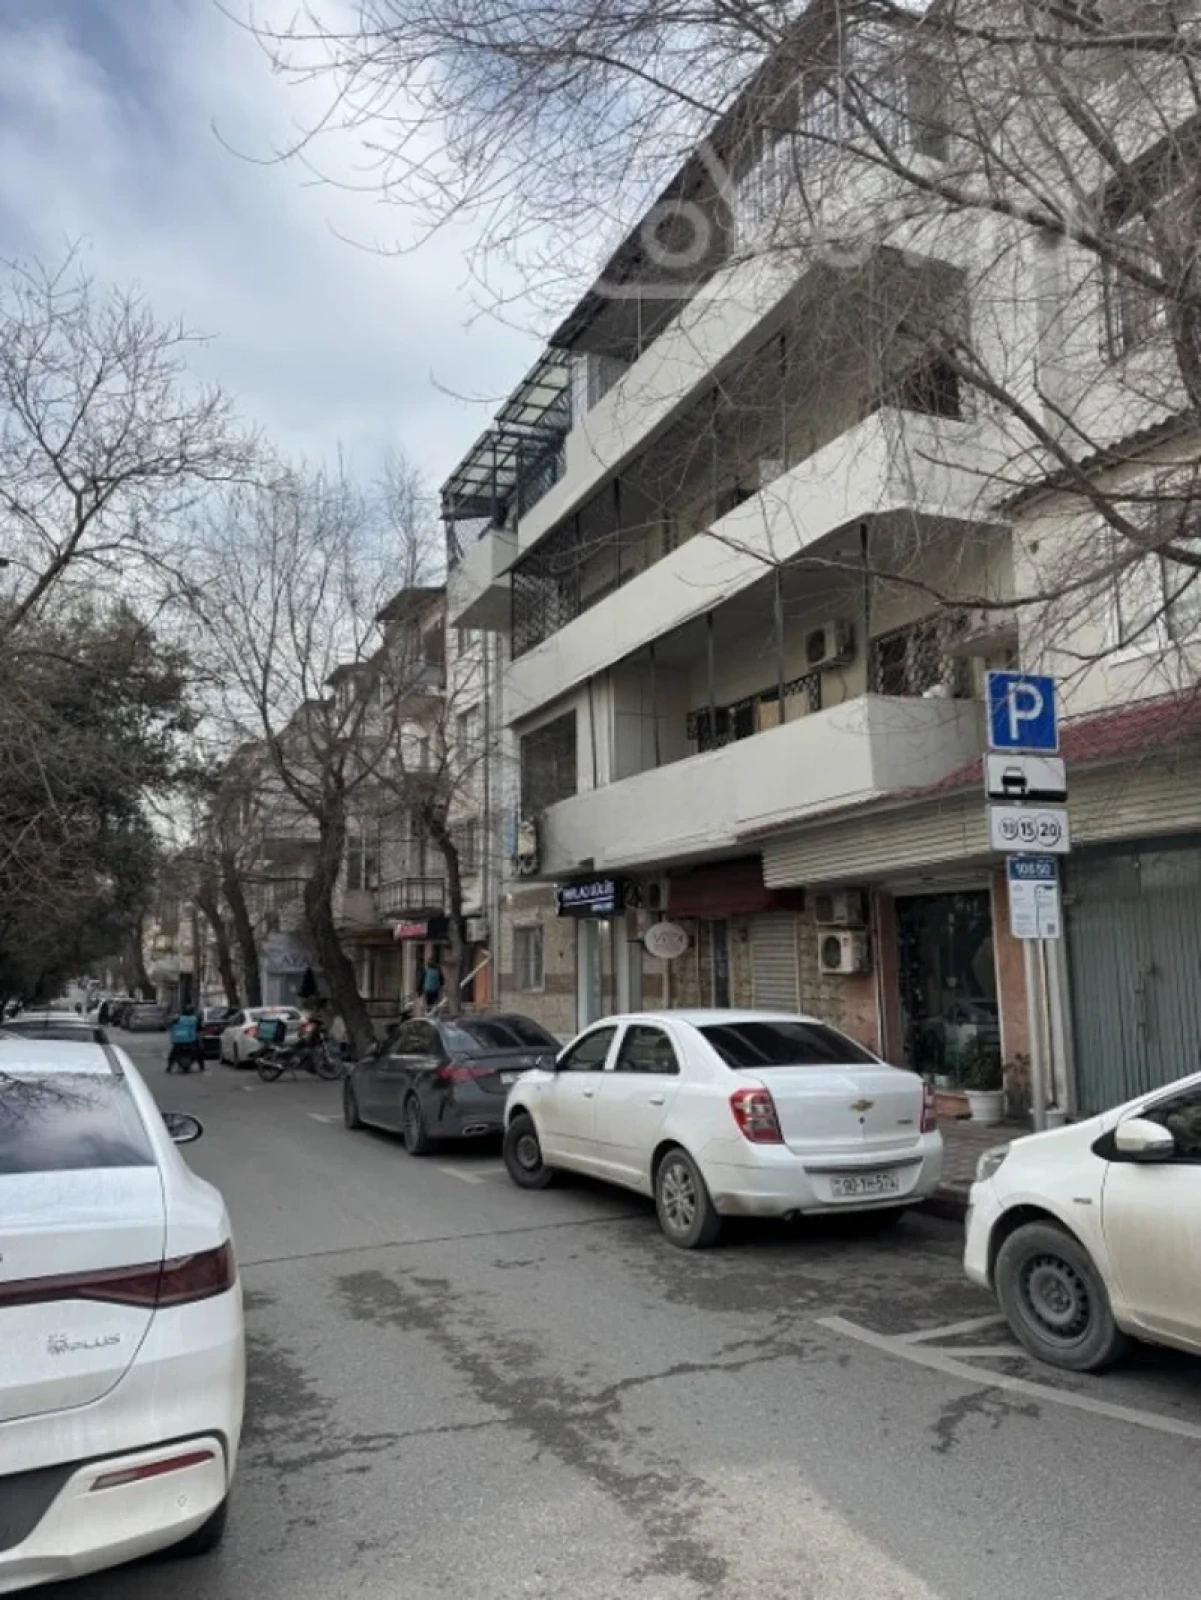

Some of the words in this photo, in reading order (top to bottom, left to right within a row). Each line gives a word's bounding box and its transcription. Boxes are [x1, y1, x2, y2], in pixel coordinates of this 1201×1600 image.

[1008, 682, 1044, 741] P
[1020, 822, 1035, 837] 15
[1039, 822, 1058, 837] 20
